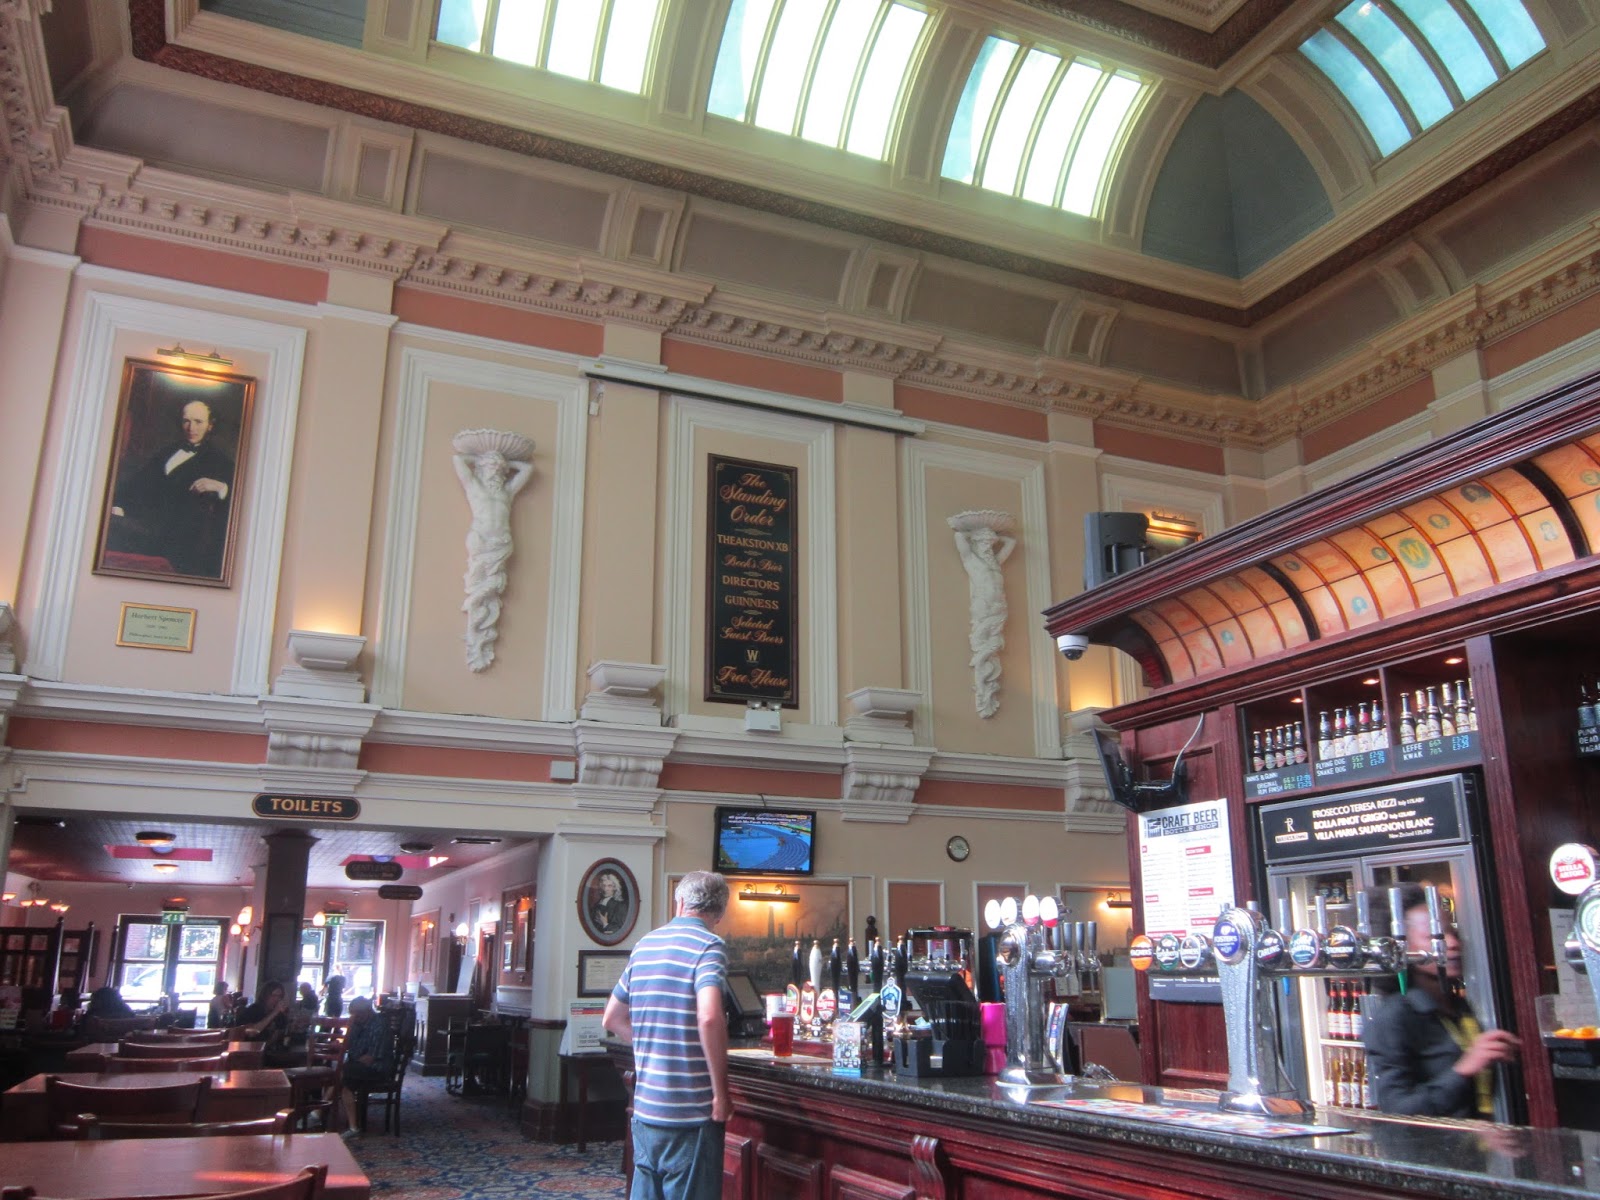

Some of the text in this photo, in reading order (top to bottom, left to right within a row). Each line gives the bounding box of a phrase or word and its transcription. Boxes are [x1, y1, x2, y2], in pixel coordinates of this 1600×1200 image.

[740, 473, 767, 488] The
[719, 483, 788, 512] Standing
[730, 504, 775, 526] Order
[717, 534, 789, 552] THEAKSTON XB
[758, 558, 783, 572] Bier
[722, 575, 780, 591] DIRECTORS
[724, 595, 779, 610] GUINNESS
[131, 612, 184, 624] Herbert Spencer
[731, 615, 775, 630] Selected
[720, 626, 784, 644] Guest Beers
[746, 650, 759, 662] W
[717, 665, 789, 688] Free House
[1402, 743, 1423, 753] LEFFE
[1403, 751, 1424, 761] KWAK
[1315, 760, 1333, 770] FLYING
[1316, 768, 1334, 777] SNAKE
[270, 798, 343, 813] TOILETS
[1312, 806, 1350, 819] PROSECCO
[1350, 801, 1376, 814] TERESA
[1377, 798, 1397, 809] RIZZI
[1161, 813, 1191, 829] CRAFT
[1193, 808, 1218, 824] BEER
[1313, 818, 1337, 830] BOLLA
[1337, 814, 1360, 827] PINOT
[1361, 811, 1388, 823] GRIGIO
[1164, 822, 1218, 836] BOTTLE SHOP
[1314, 817, 1434, 841] VILLA MARIA SAUVIGNON BLANC
[1558, 863, 1584, 873] STELLA
[1559, 870, 1586, 879] ARTOIS
[1257, 945, 1281, 959] CARLING
